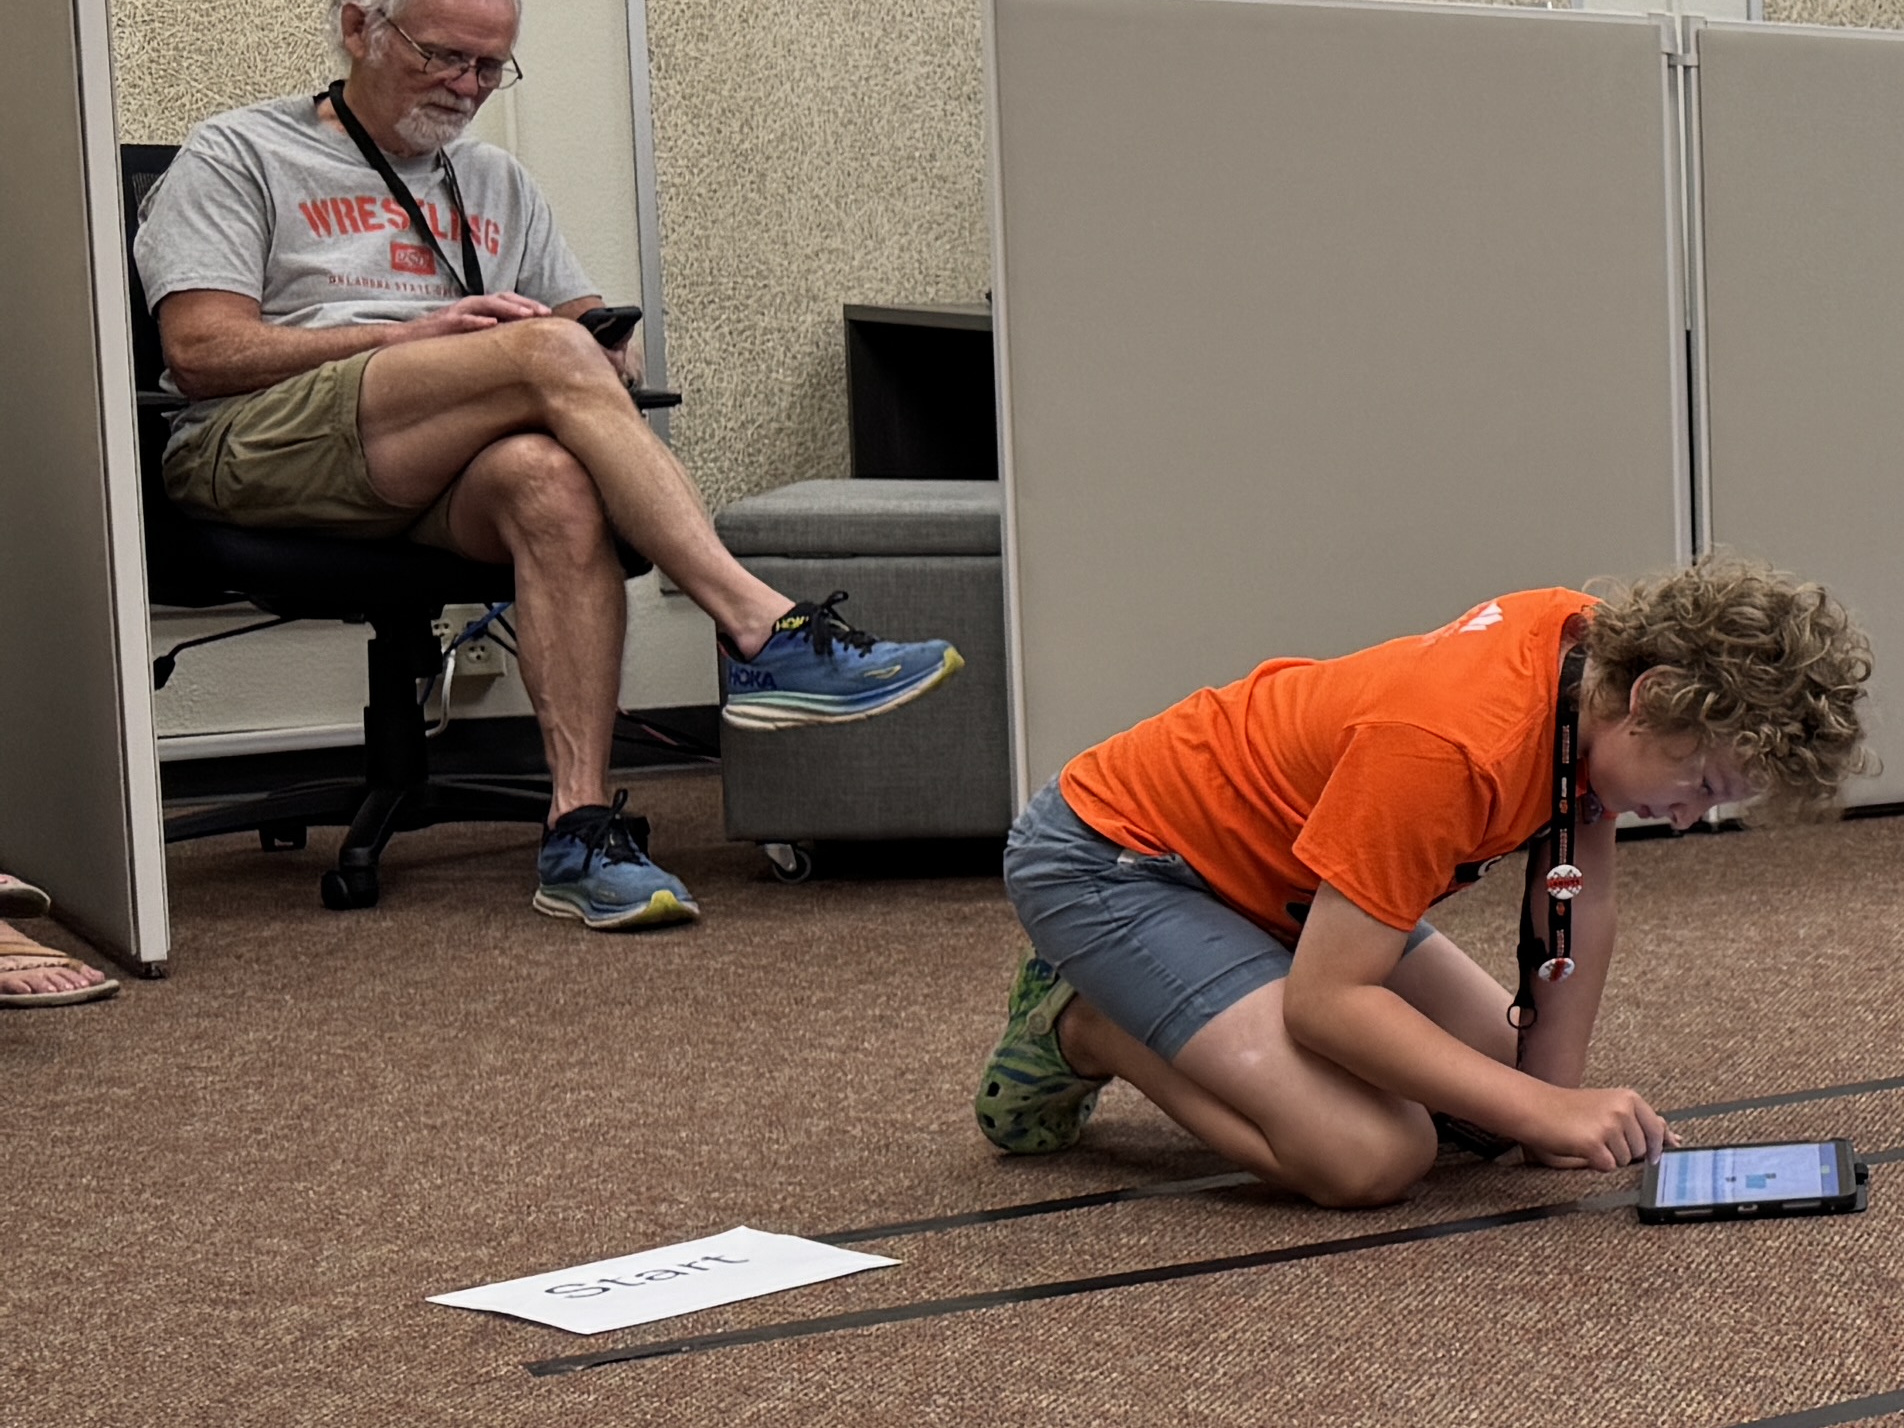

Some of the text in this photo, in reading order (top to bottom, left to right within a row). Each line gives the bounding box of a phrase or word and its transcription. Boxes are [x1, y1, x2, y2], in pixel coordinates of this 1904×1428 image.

[299, 195, 499, 256] WRESLING
[728, 665, 776, 690] HOKA
[544, 1254, 750, 1299] Start
